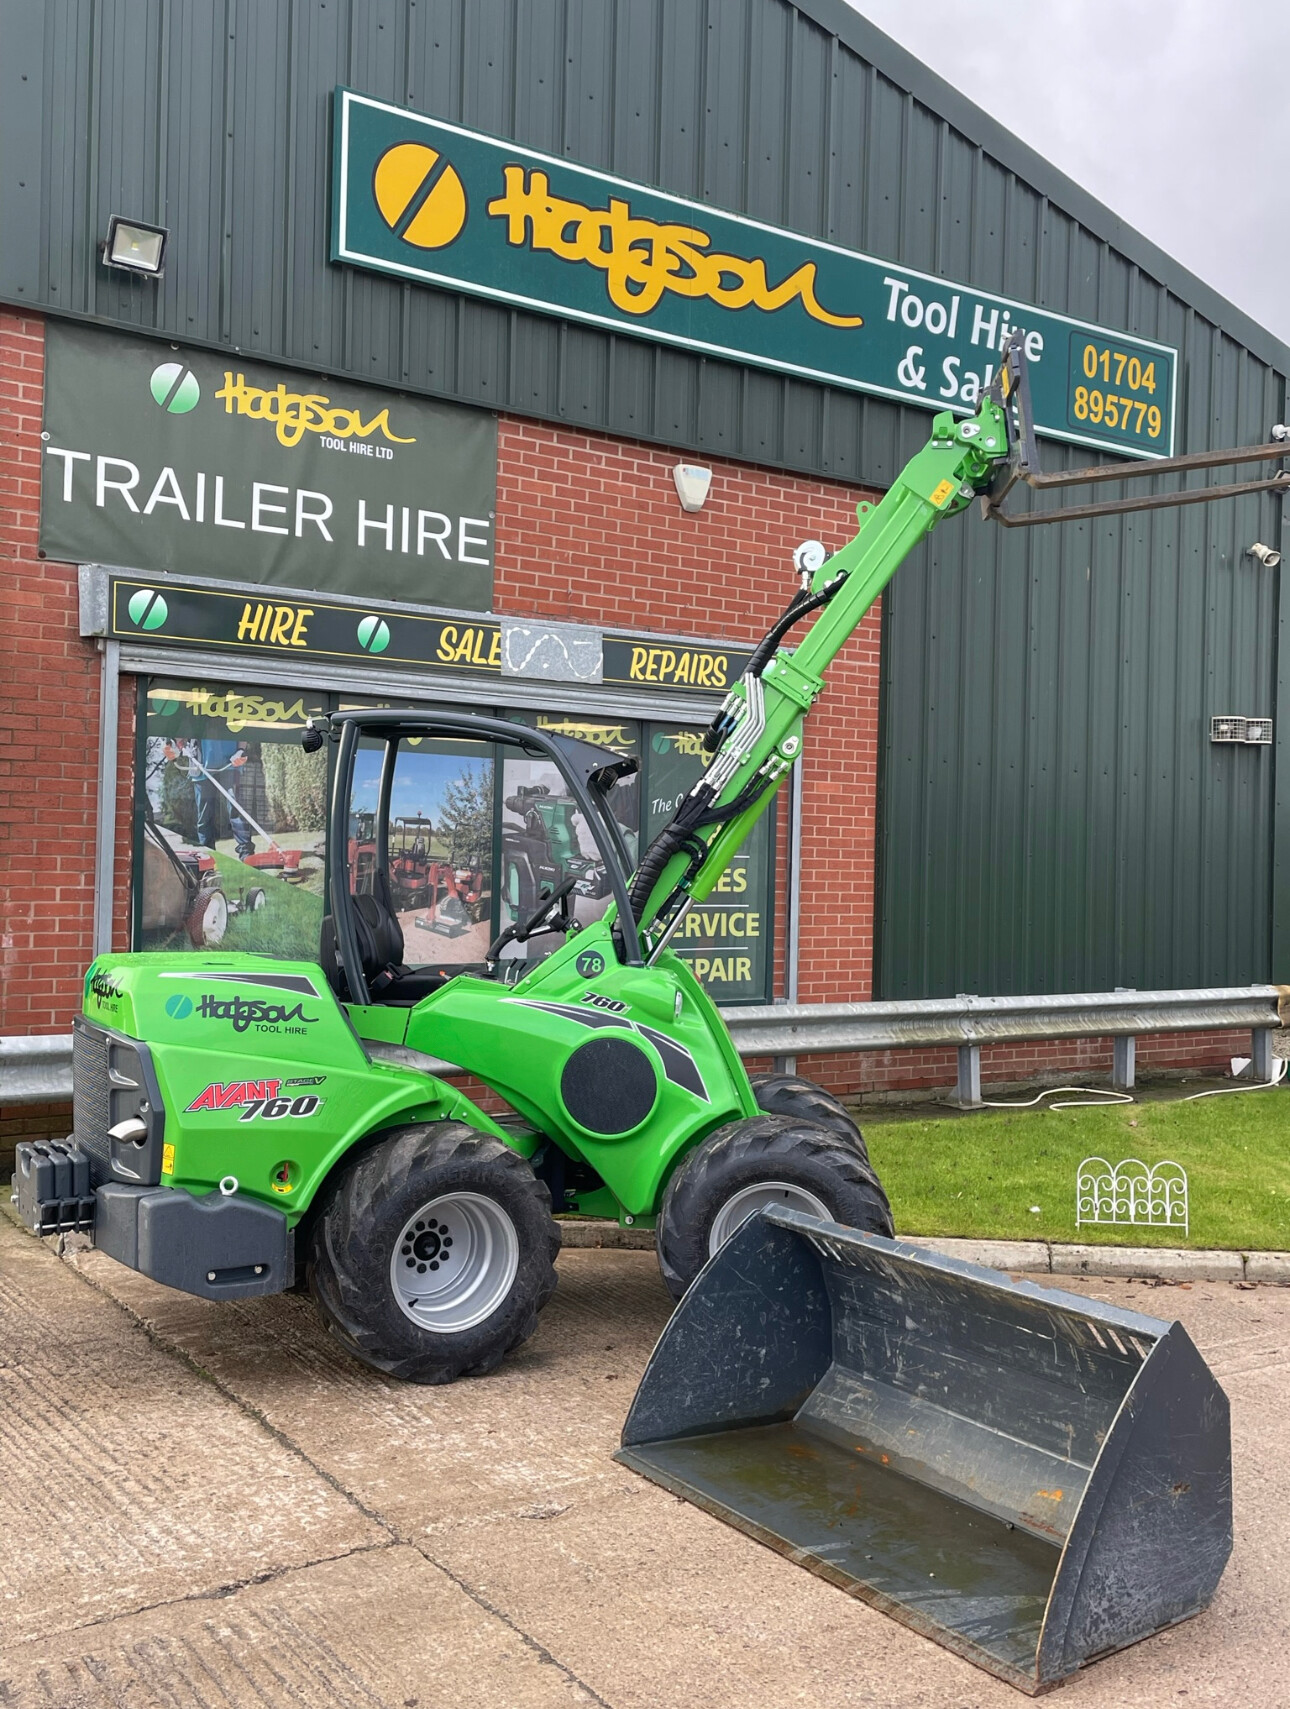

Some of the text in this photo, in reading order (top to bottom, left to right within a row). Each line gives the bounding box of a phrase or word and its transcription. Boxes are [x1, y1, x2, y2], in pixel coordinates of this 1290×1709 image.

[488, 164, 864, 329] Hodgson
[883, 276, 960, 339] Tool
[897, 345, 927, 391] &
[1082, 344, 1157, 394] 01704
[214, 371, 417, 448] Hodgson
[1073, 386, 1161, 438] 895779
[320, 436, 394, 459] TOOL HIRE LTD
[46, 446, 490, 566] TRAILER HIRE
[237, 603, 315, 646] HIRE
[630, 647, 728, 687] REPAIRS
[651, 798, 672, 815] The
[581, 957, 602, 973] 78
[686, 957, 752, 982] PAIR
[196, 994, 319, 1032] Hodgson
[255, 1024, 308, 1035] TOOL HIRE
[184, 1079, 282, 1112] AVANT
